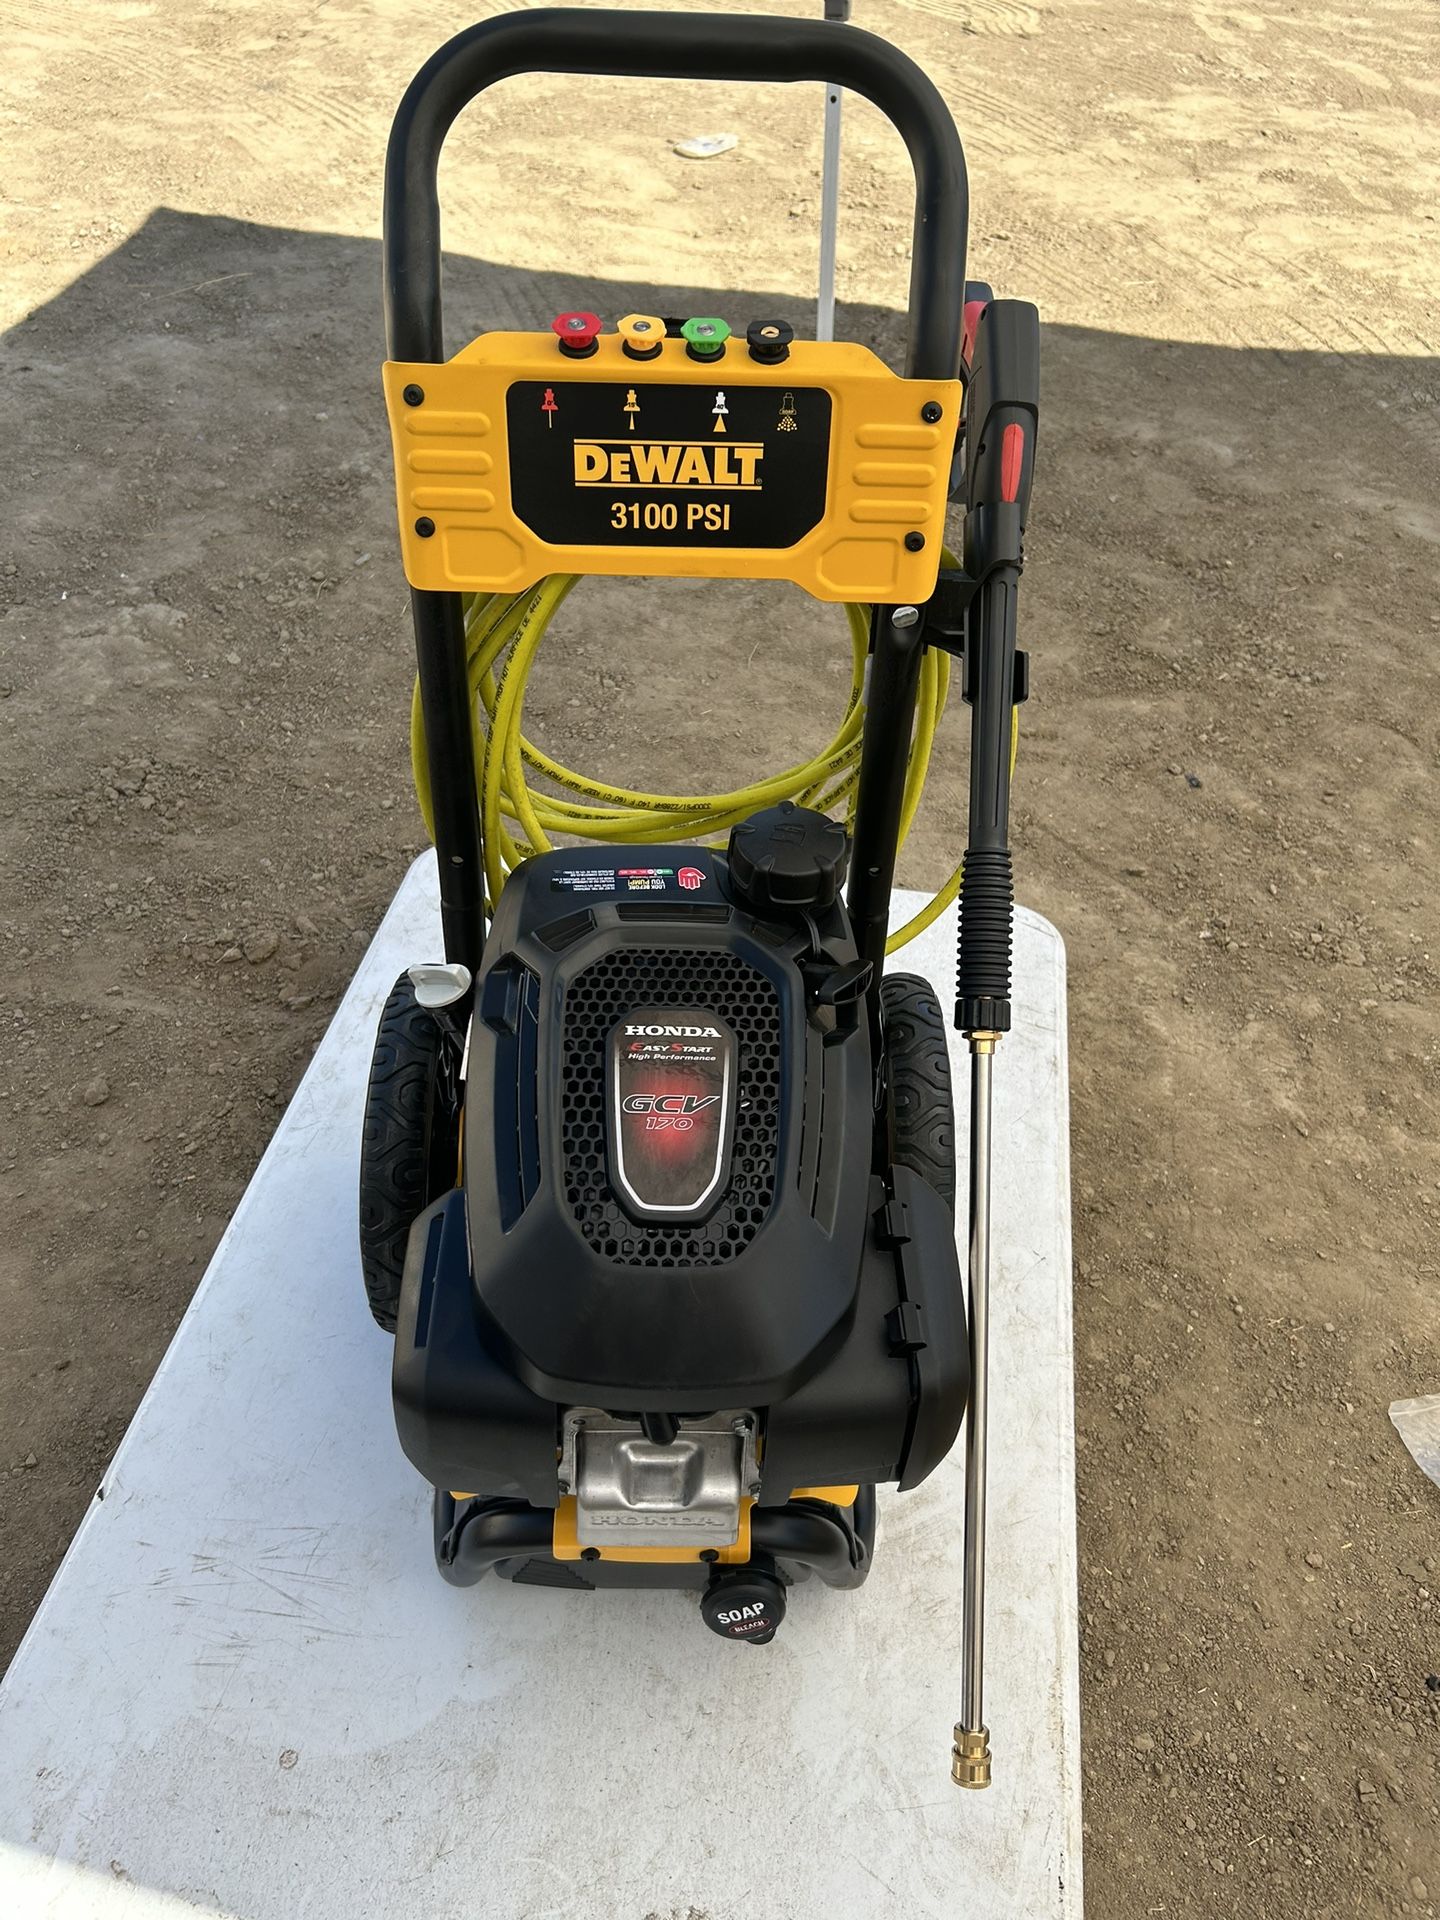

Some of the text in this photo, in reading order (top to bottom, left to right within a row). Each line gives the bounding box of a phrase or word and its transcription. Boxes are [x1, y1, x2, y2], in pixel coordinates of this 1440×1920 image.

[611, 502, 730, 531] 3100 PSI
[501, 664, 510, 681] HOT
[529, 594, 542, 614] 4421
[532, 759, 546, 771] HOT
[829, 758, 844, 769] 4421
[545, 769, 564, 782] FROM
[582, 786, 601, 797] KEEP
[625, 1025, 722, 1038] HONDA
[630, 1042, 714, 1053] EASY START
[628, 1053, 716, 1061] High Performance
[622, 1093, 721, 1115] GCV
[646, 1116, 694, 1131] 170
[591, 1516, 725, 1526] HONDA
[717, 1602, 765, 1625] SOAP
[734, 1620, 765, 1633] BLEACH
